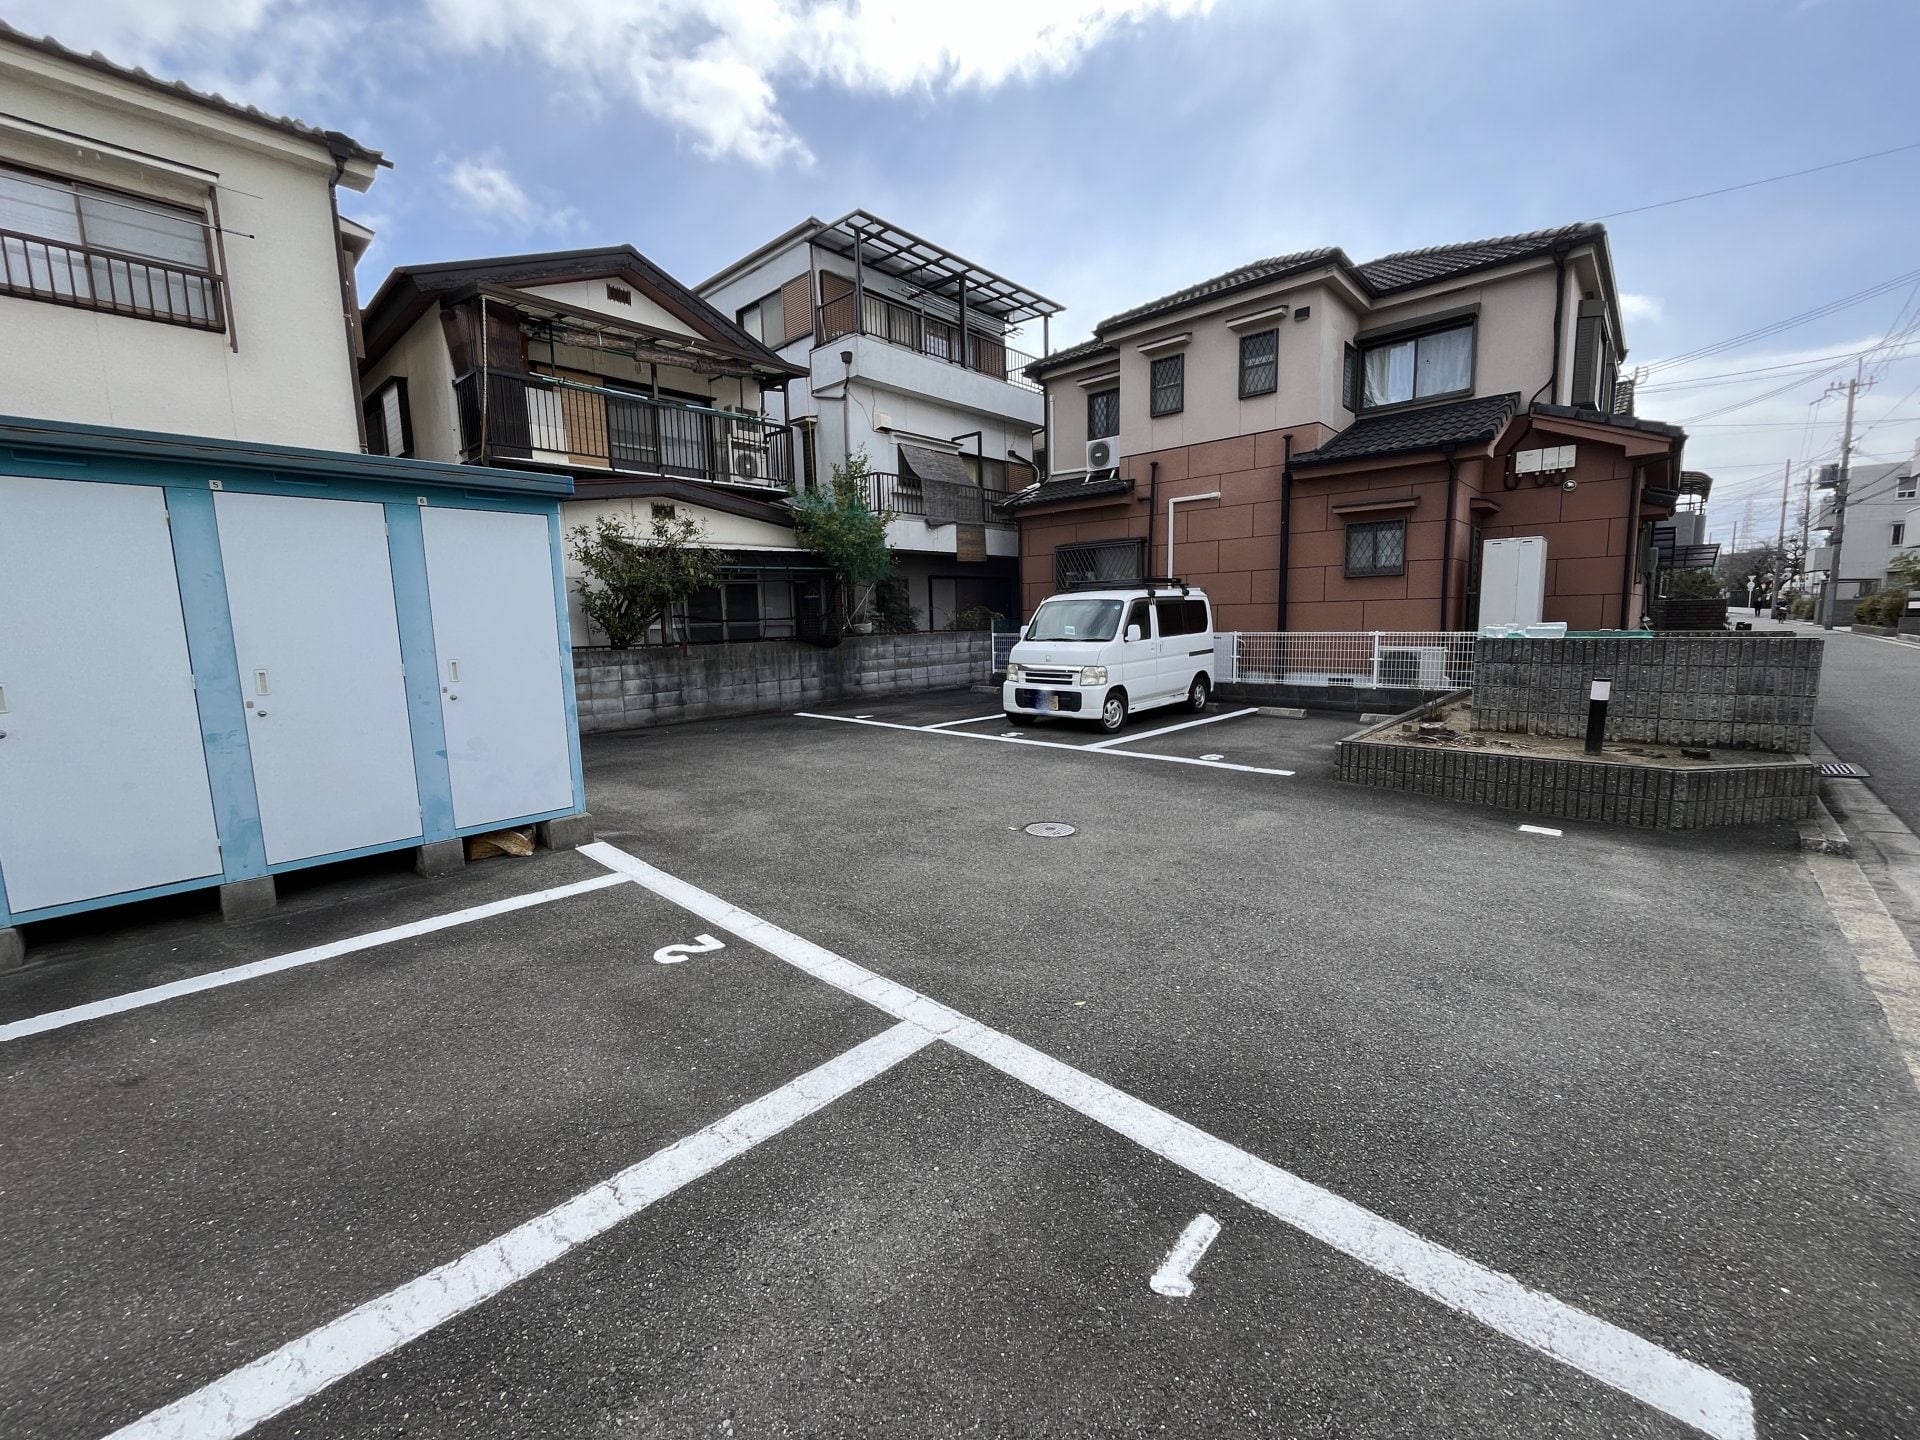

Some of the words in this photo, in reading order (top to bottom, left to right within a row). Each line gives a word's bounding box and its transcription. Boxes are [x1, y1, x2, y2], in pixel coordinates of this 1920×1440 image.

[212, 481, 219, 489] 5
[653, 933, 726, 964] 2
[1149, 1212, 1222, 1298] 1
